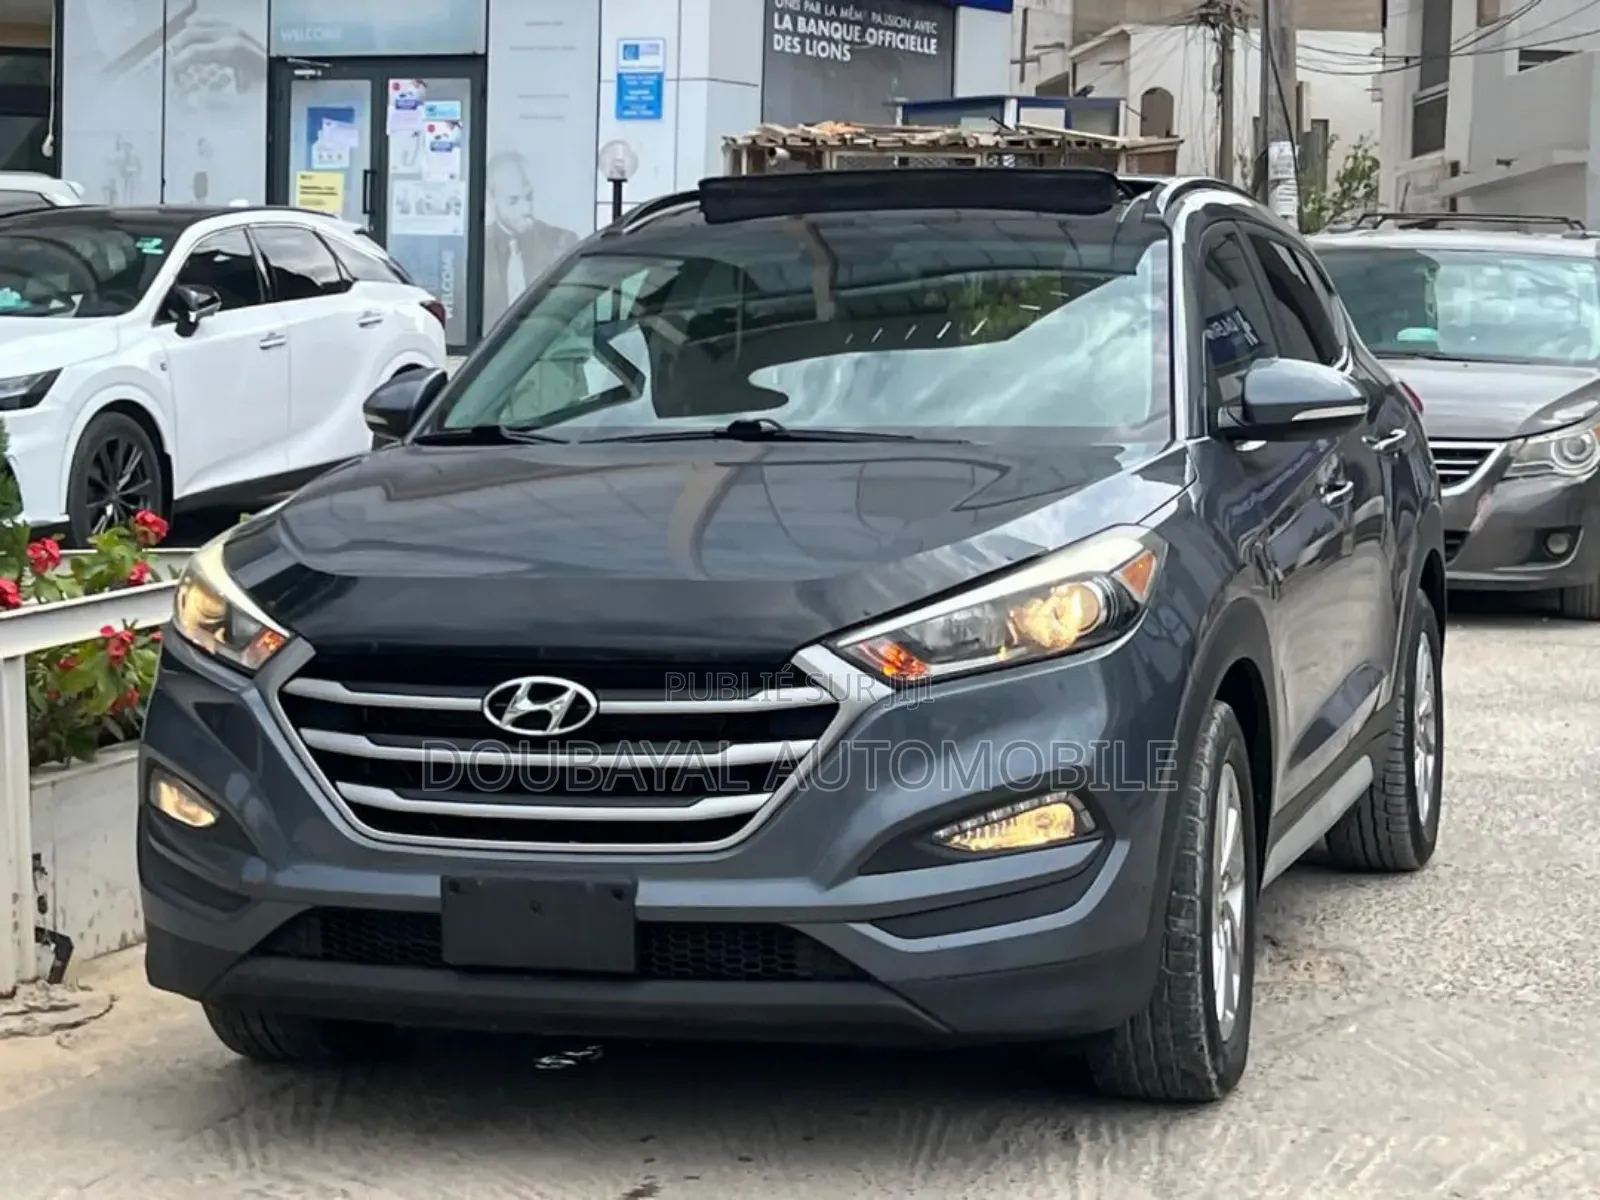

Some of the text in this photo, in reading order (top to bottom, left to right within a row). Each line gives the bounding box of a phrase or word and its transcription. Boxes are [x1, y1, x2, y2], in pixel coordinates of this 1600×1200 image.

[773, 12, 937, 55] LA BANQUE OFFICIELLE
[804, 1, 821, 14] PAR
[825, 5, 837, 17] LA
[840, 4, 868, 22] MÊM
[914, 20, 937, 34] AVEC
[773, 34, 851, 62] DES LIONS
